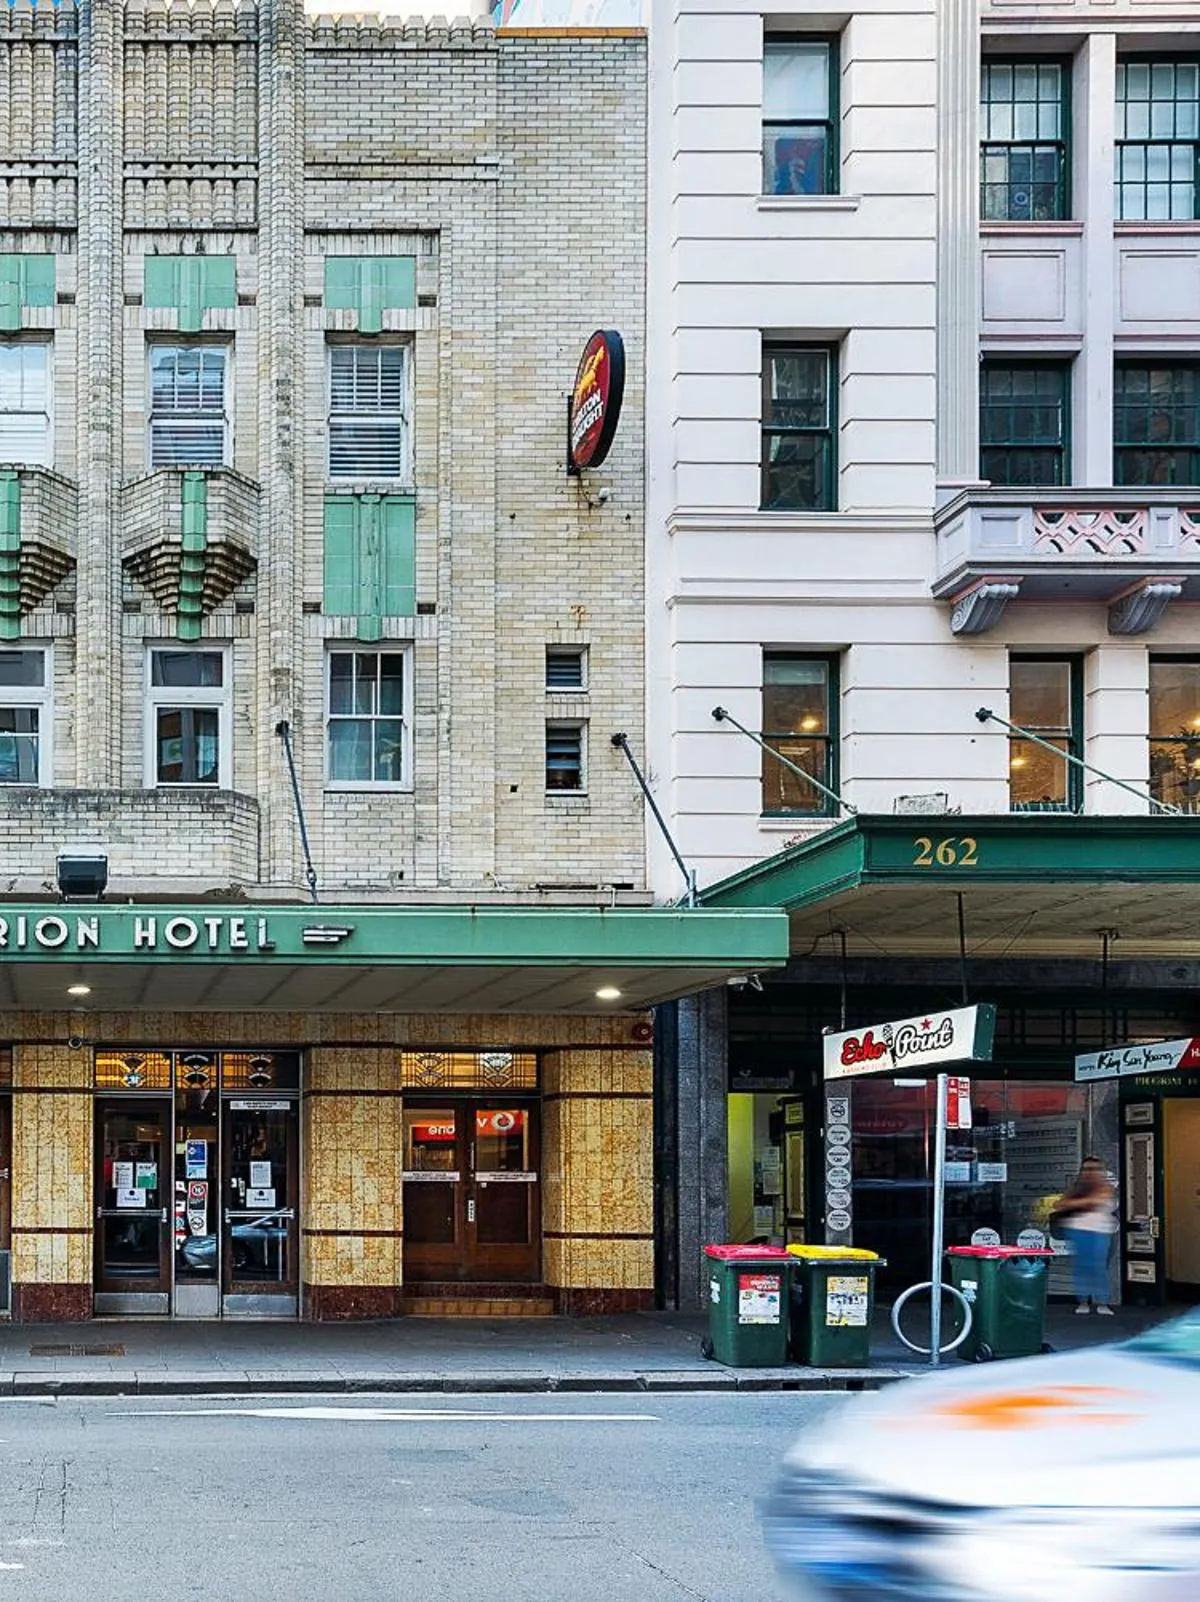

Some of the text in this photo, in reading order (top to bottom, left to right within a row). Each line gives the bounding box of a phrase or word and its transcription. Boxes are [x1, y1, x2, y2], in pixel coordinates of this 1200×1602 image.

[912, 837, 979, 866] 262
[134, 916, 276, 949] HOTEL
[841, 1017, 954, 1066] Echo Point
